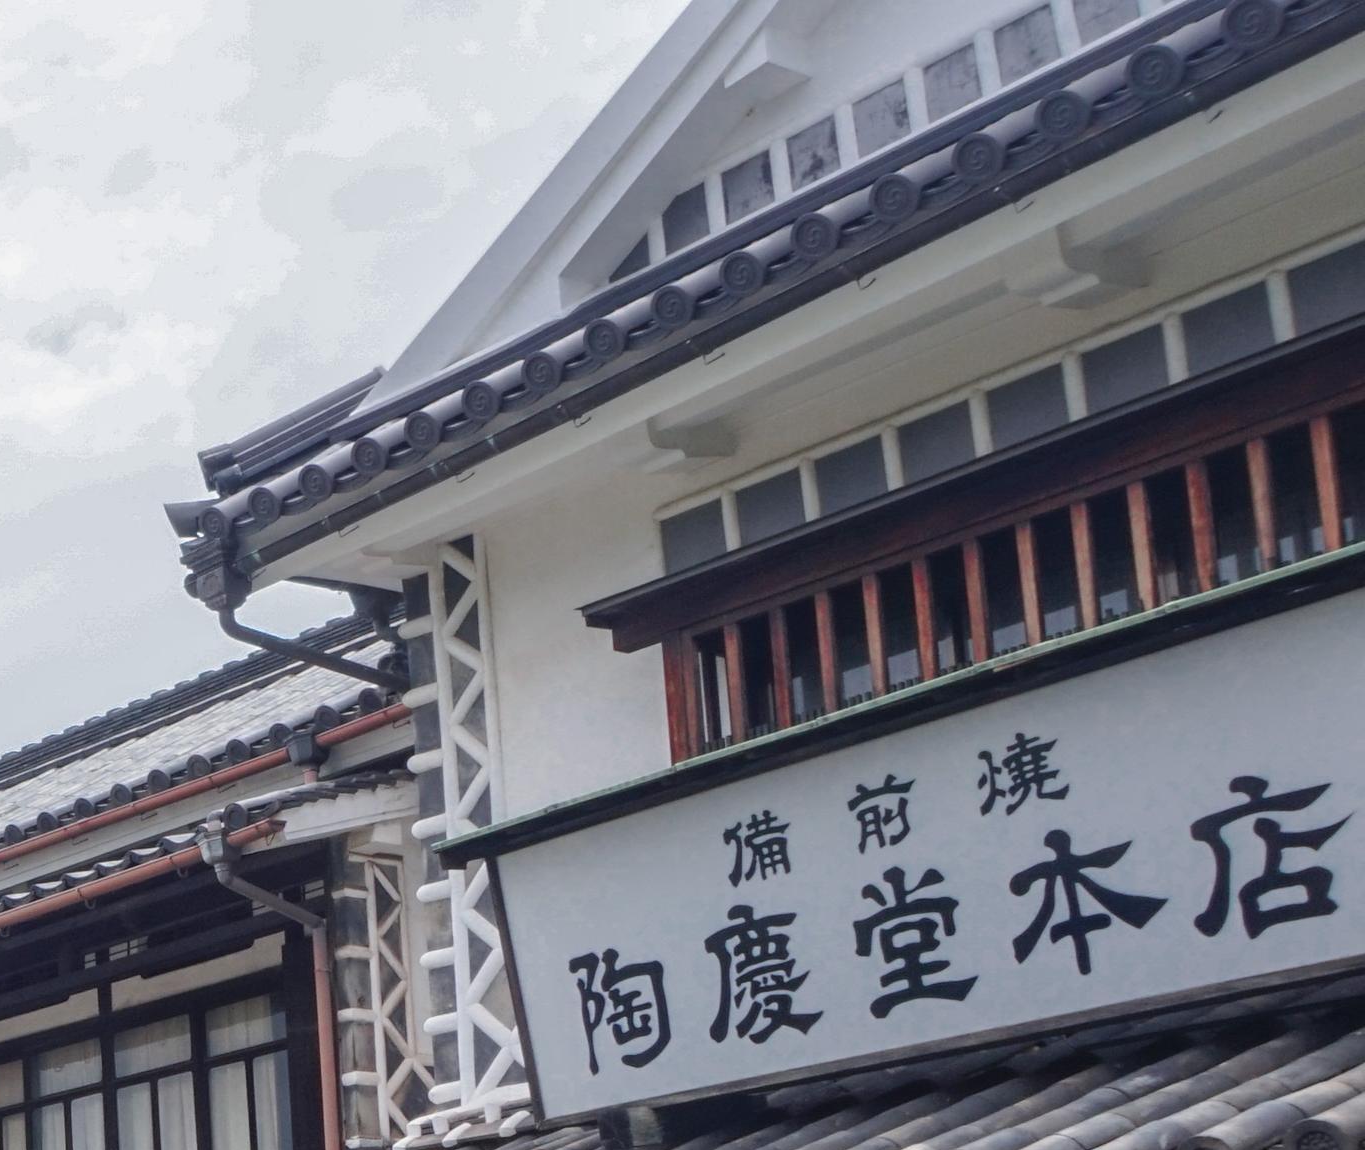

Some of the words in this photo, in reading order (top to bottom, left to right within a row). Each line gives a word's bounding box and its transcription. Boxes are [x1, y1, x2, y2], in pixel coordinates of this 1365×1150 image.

[568, 775, 1355, 1076] 陶慶堂本店
